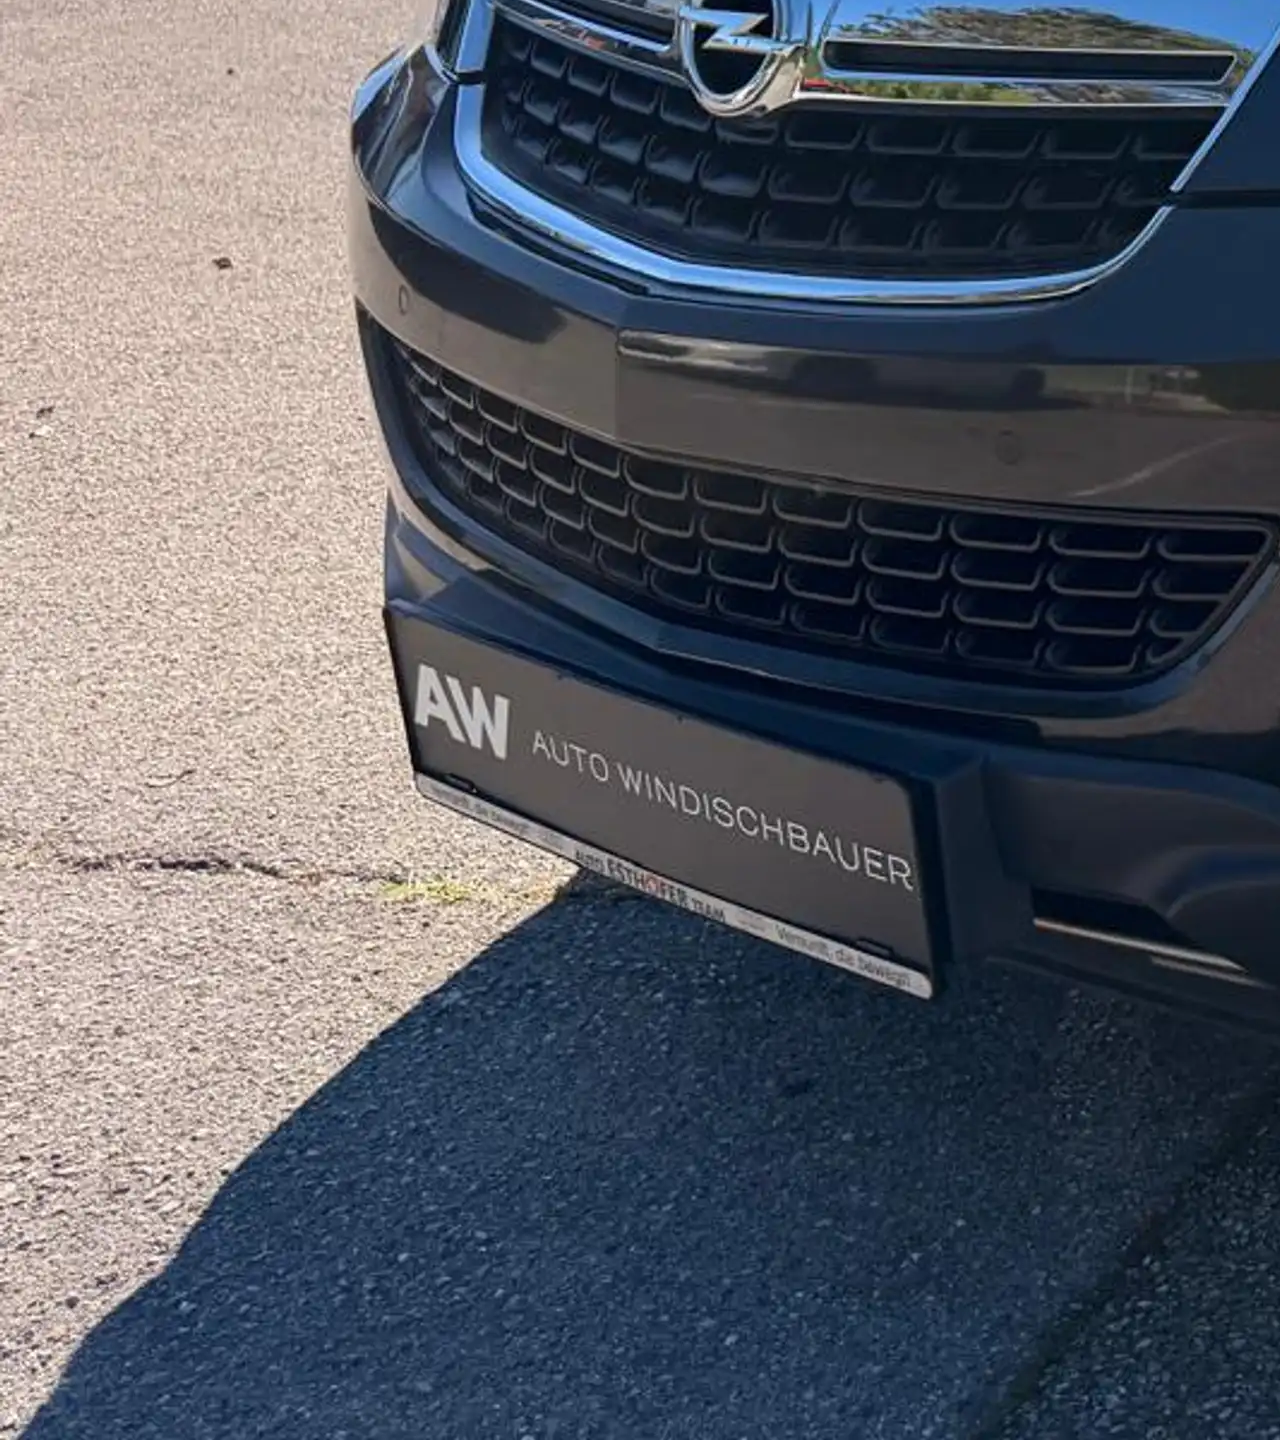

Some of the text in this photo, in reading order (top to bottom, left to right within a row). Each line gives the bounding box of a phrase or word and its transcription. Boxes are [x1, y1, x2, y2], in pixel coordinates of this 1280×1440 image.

[414, 662, 510, 761] AW
[532, 729, 610, 782] AUTO
[616, 762, 915, 891] WINDISCHBAUER
